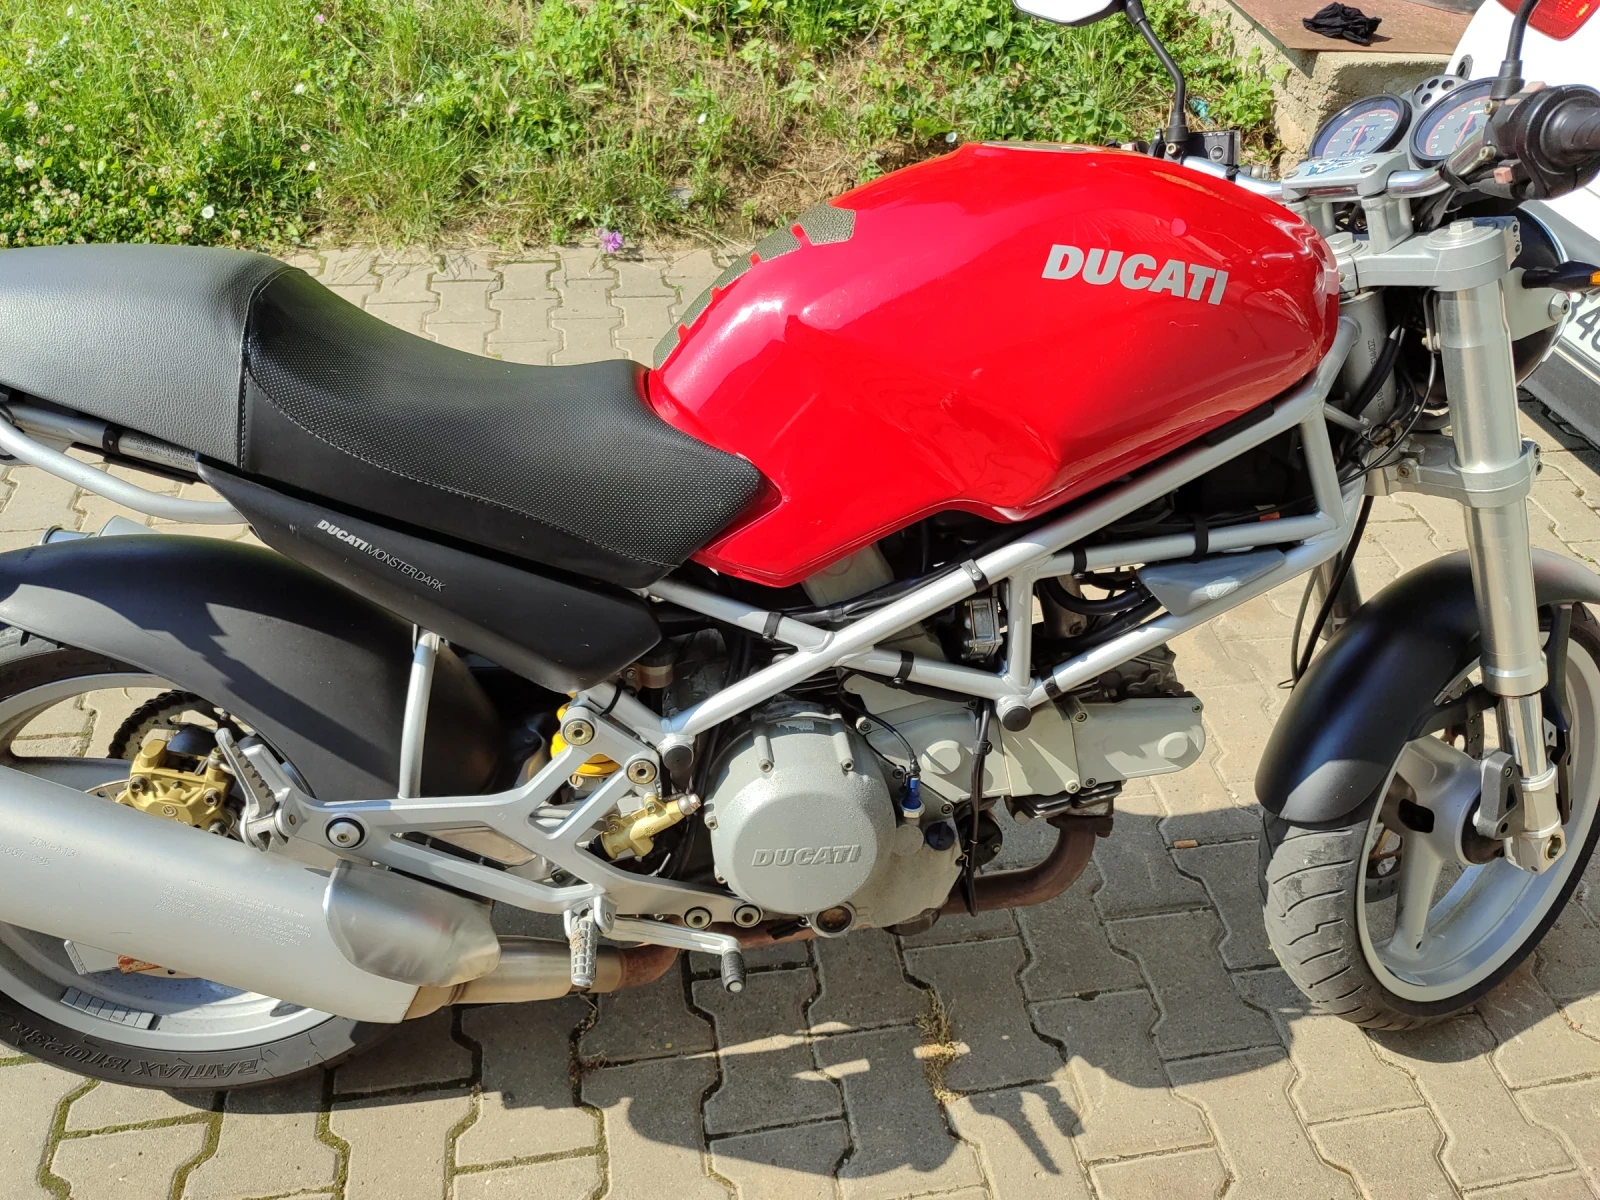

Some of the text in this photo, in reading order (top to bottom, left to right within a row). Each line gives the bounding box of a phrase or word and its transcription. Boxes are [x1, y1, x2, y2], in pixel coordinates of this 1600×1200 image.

[1041, 244, 1229, 305] DUCATI
[316, 519, 369, 551] DUCATI
[751, 844, 861, 867] DUCATI
[131, 1058, 260, 1080] BATTLAX
